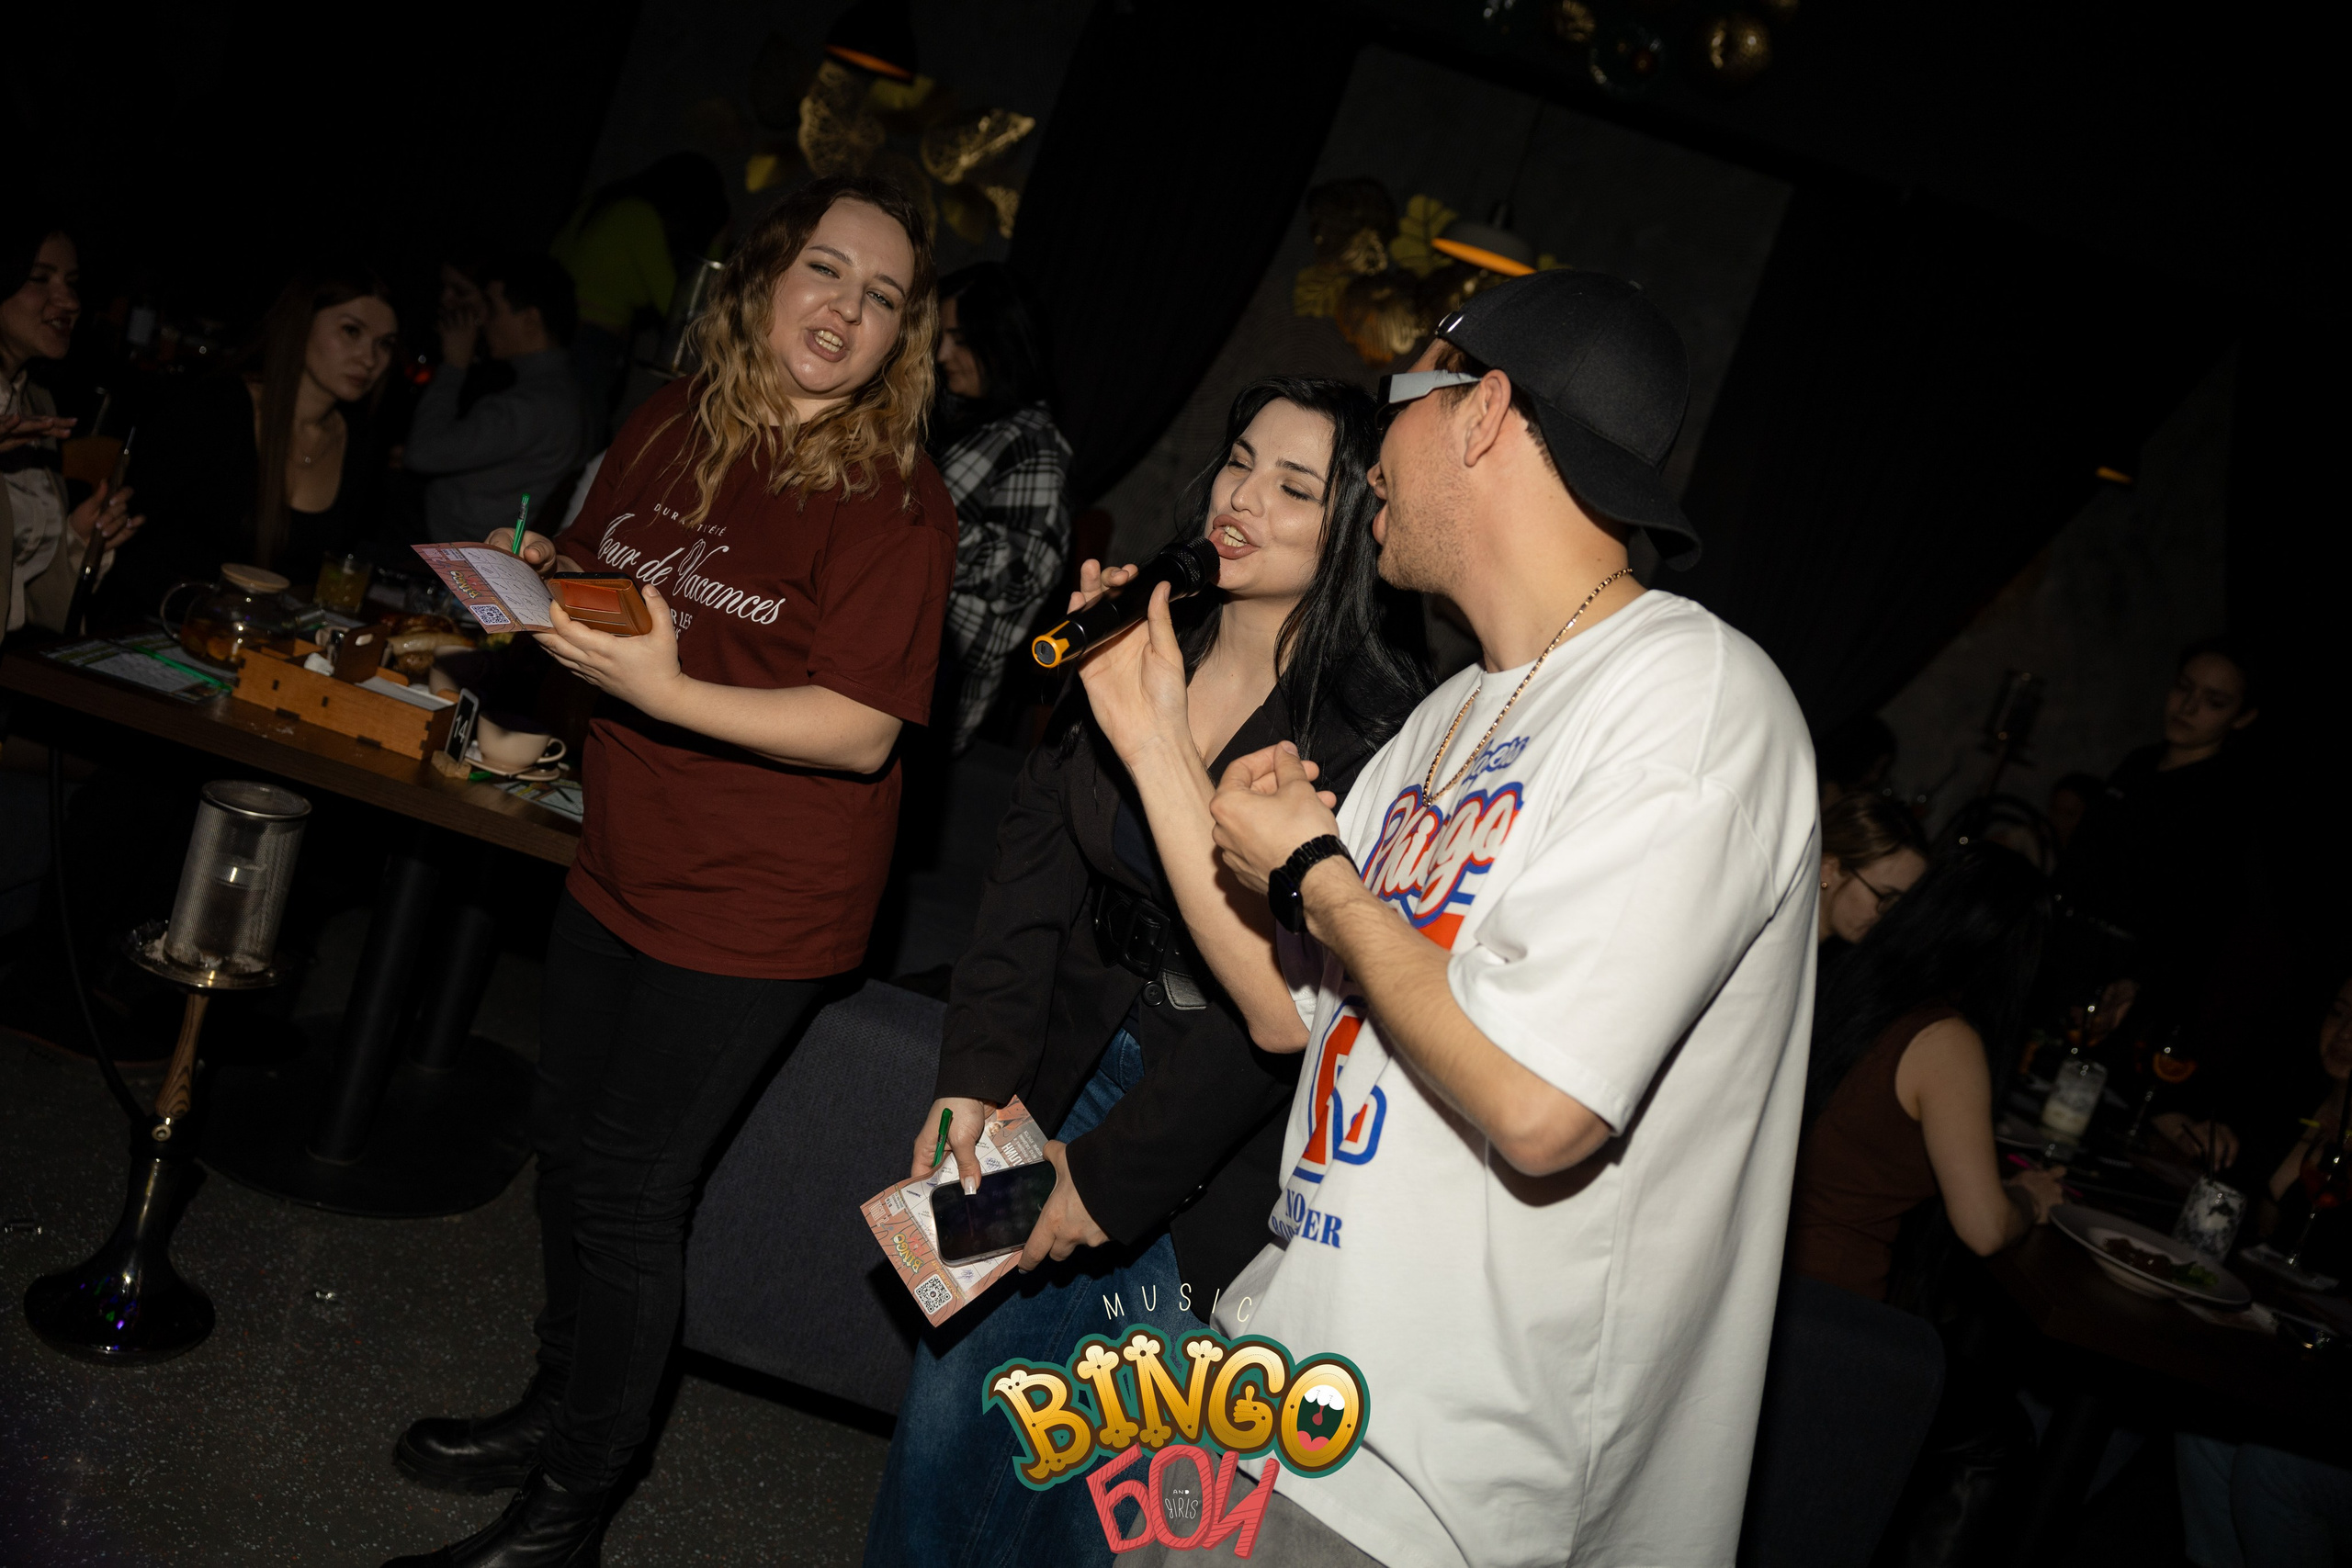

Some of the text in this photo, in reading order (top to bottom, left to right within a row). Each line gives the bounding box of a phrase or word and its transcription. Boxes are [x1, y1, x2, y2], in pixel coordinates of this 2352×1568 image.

[653, 502, 704, 532] DURAT
[636, 547, 685, 586] de
[673, 538, 786, 625] Vacances
[453, 714, 469, 744] 14
[893, 1232, 925, 1274] BINGO
